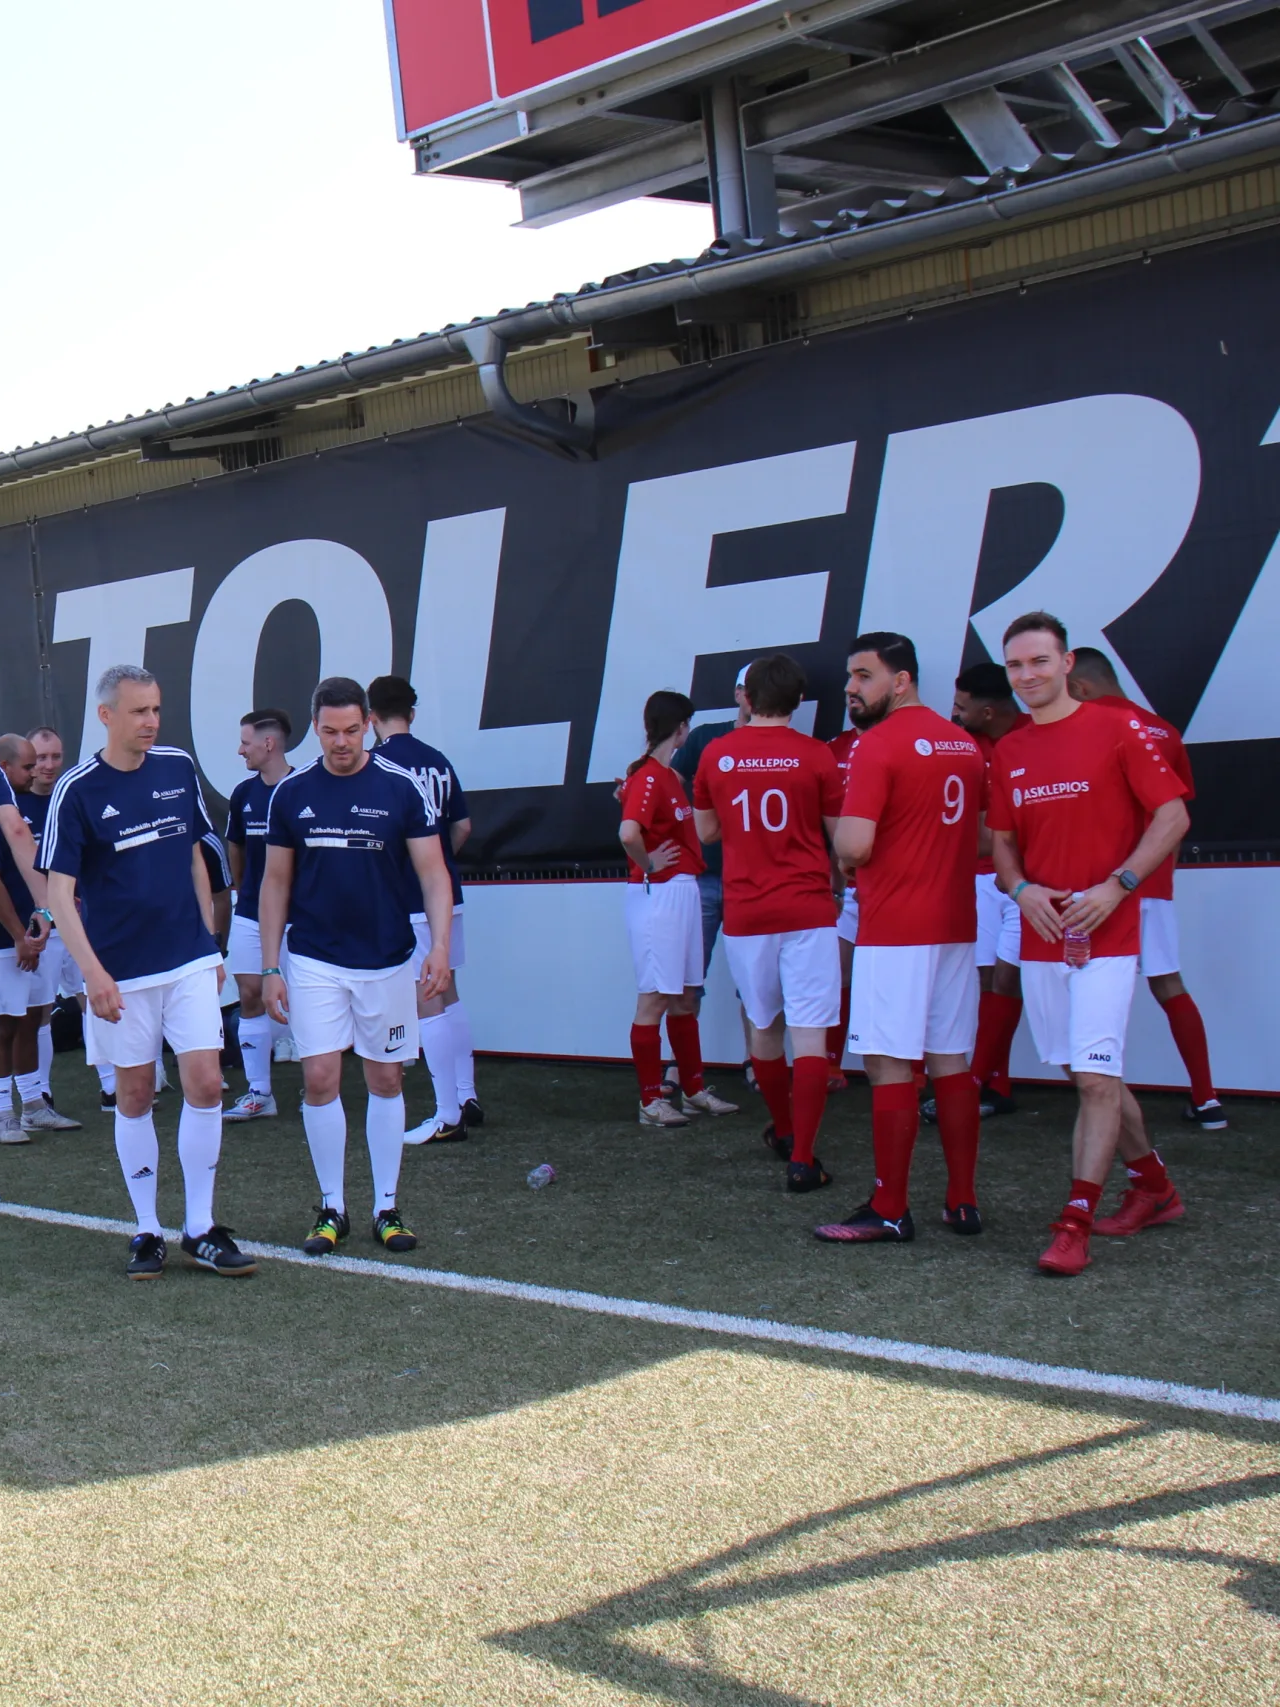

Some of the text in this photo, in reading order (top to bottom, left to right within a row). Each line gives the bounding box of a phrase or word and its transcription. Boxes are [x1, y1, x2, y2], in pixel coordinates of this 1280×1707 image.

[934, 741, 977, 752] ASKLEPIOS
[737, 758, 800, 768] ASKLEPIOS
[160, 787, 186, 797] ASKLEPIOS
[1024, 781, 1090, 799] ASKLEPIOS
[941, 774, 965, 825] 9
[358, 808, 389, 817] ASKLEPIOS
[731, 788, 788, 832] 10
[389, 1025, 405, 1041] PM
[1088, 1053, 1111, 1062] JAKO
